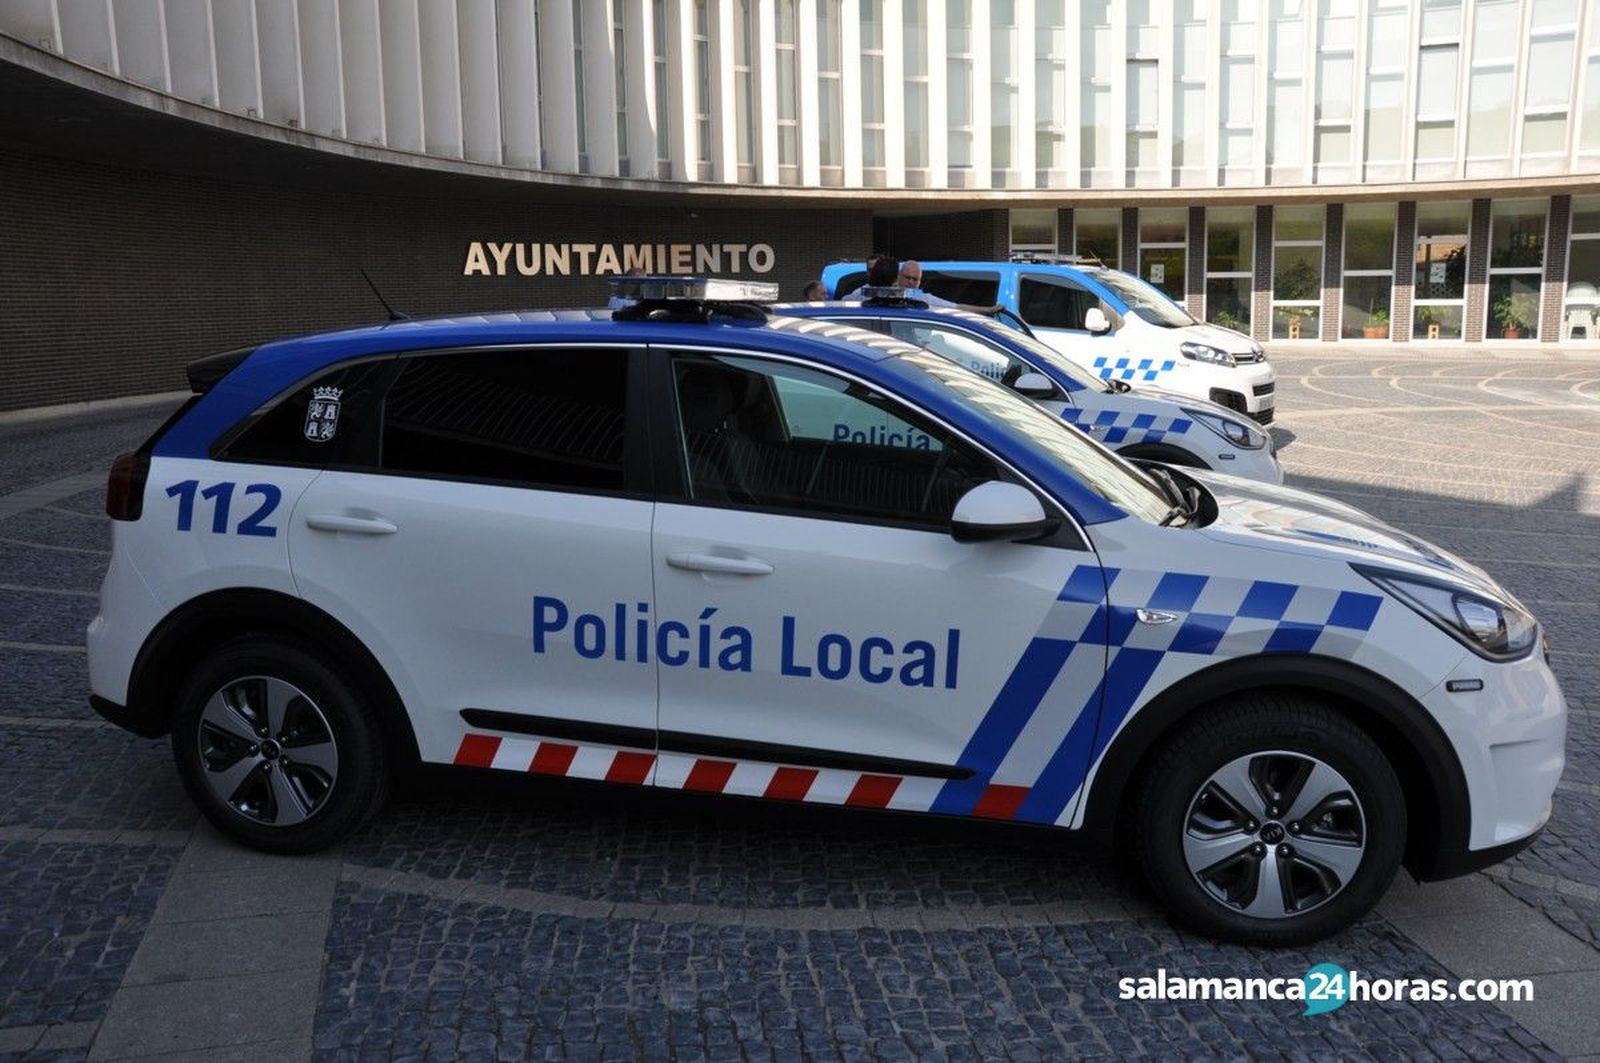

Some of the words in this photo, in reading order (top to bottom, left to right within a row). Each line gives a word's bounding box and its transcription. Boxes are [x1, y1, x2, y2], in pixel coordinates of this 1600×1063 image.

[463, 241, 776, 276] AYUNTAMIENTO
[165, 480, 282, 537] 112
[532, 595, 753, 673] Policía
[780, 615, 961, 690] Local
